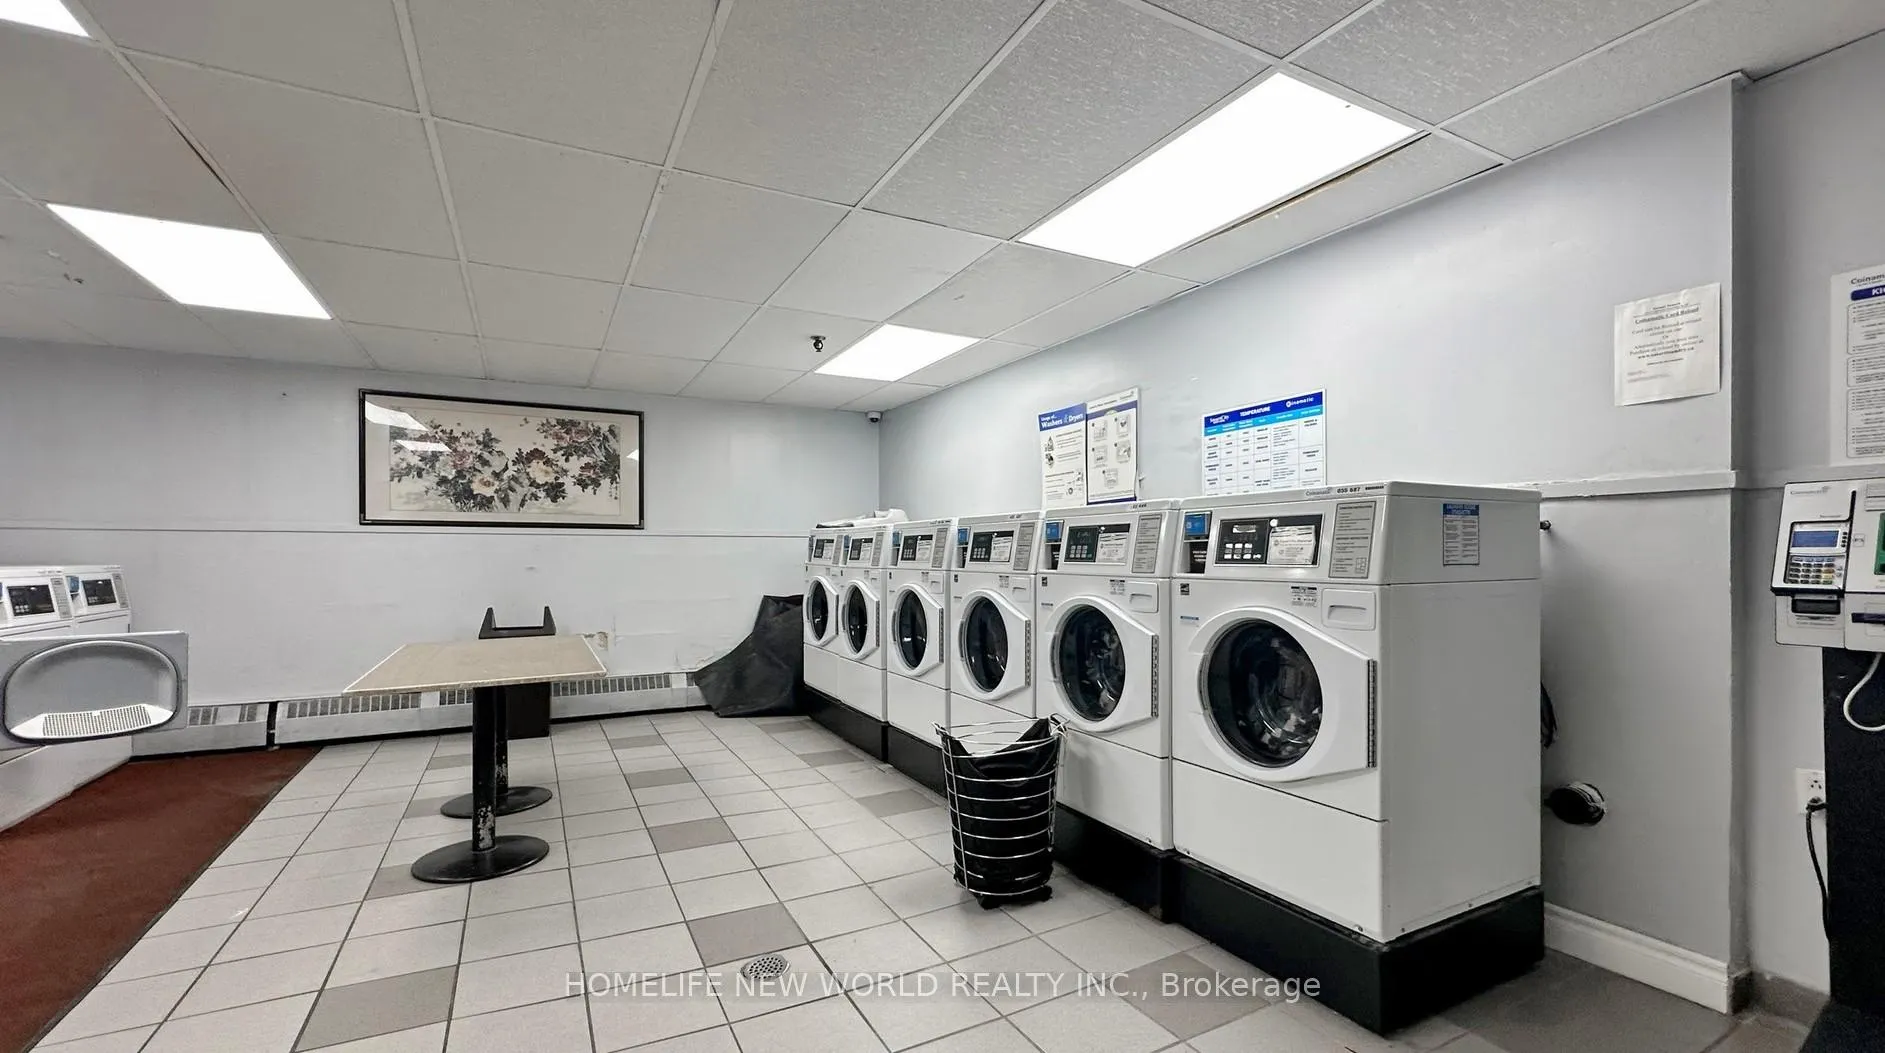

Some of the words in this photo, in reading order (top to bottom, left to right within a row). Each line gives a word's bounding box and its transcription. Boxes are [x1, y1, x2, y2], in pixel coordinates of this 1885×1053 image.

[1872, 287, 1885, 296] KI
[1041, 419, 1063, 429] Washers
[1068, 413, 1083, 422] Dryers
